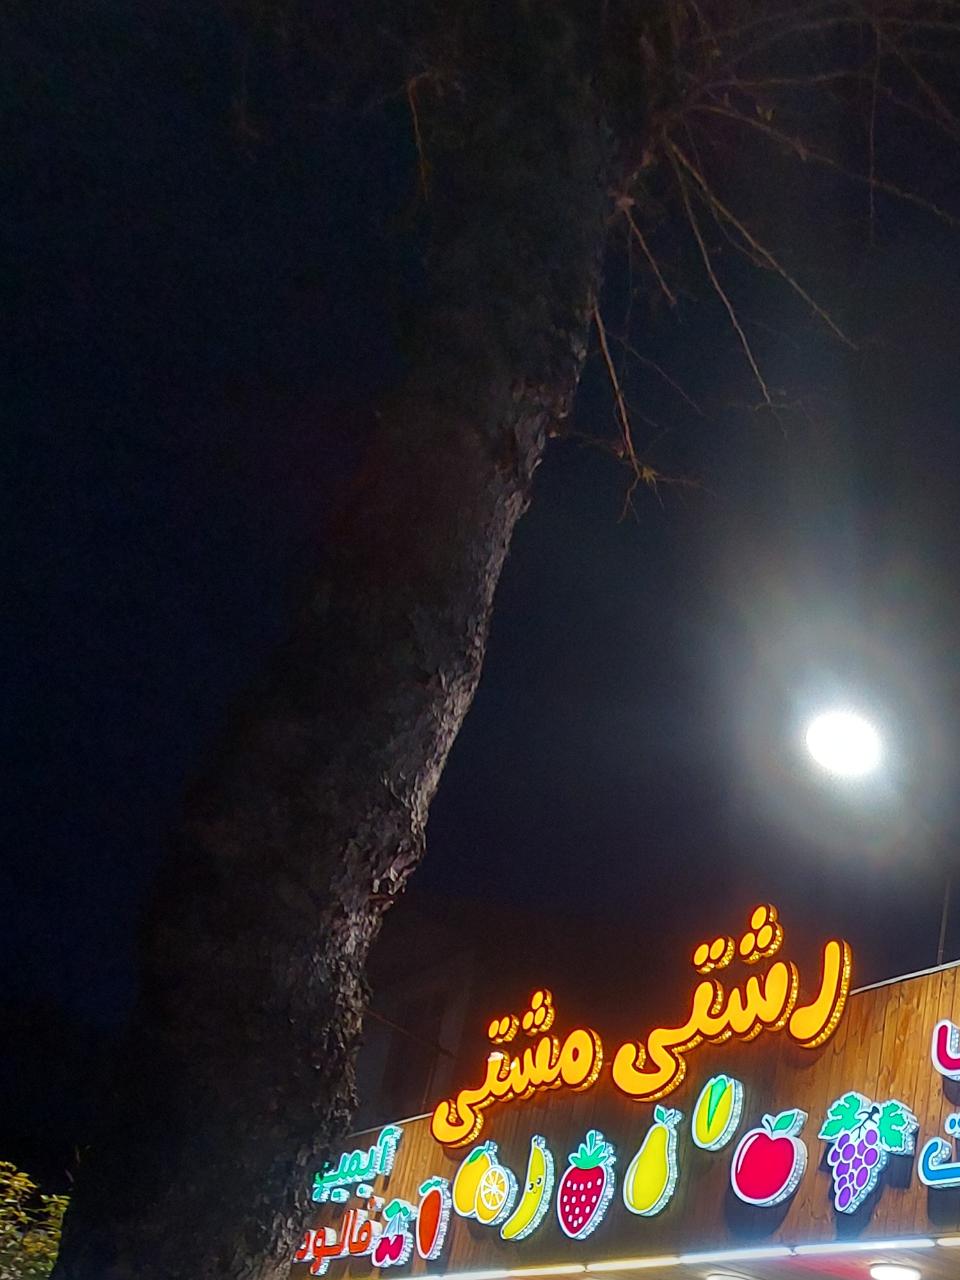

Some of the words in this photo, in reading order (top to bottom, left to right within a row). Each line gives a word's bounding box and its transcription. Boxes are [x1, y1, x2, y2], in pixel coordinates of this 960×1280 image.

[431, 989, 602, 1148] مشتی
[611, 903, 851, 1101] رشتی
[293, 1195, 385, 1276] فالود
